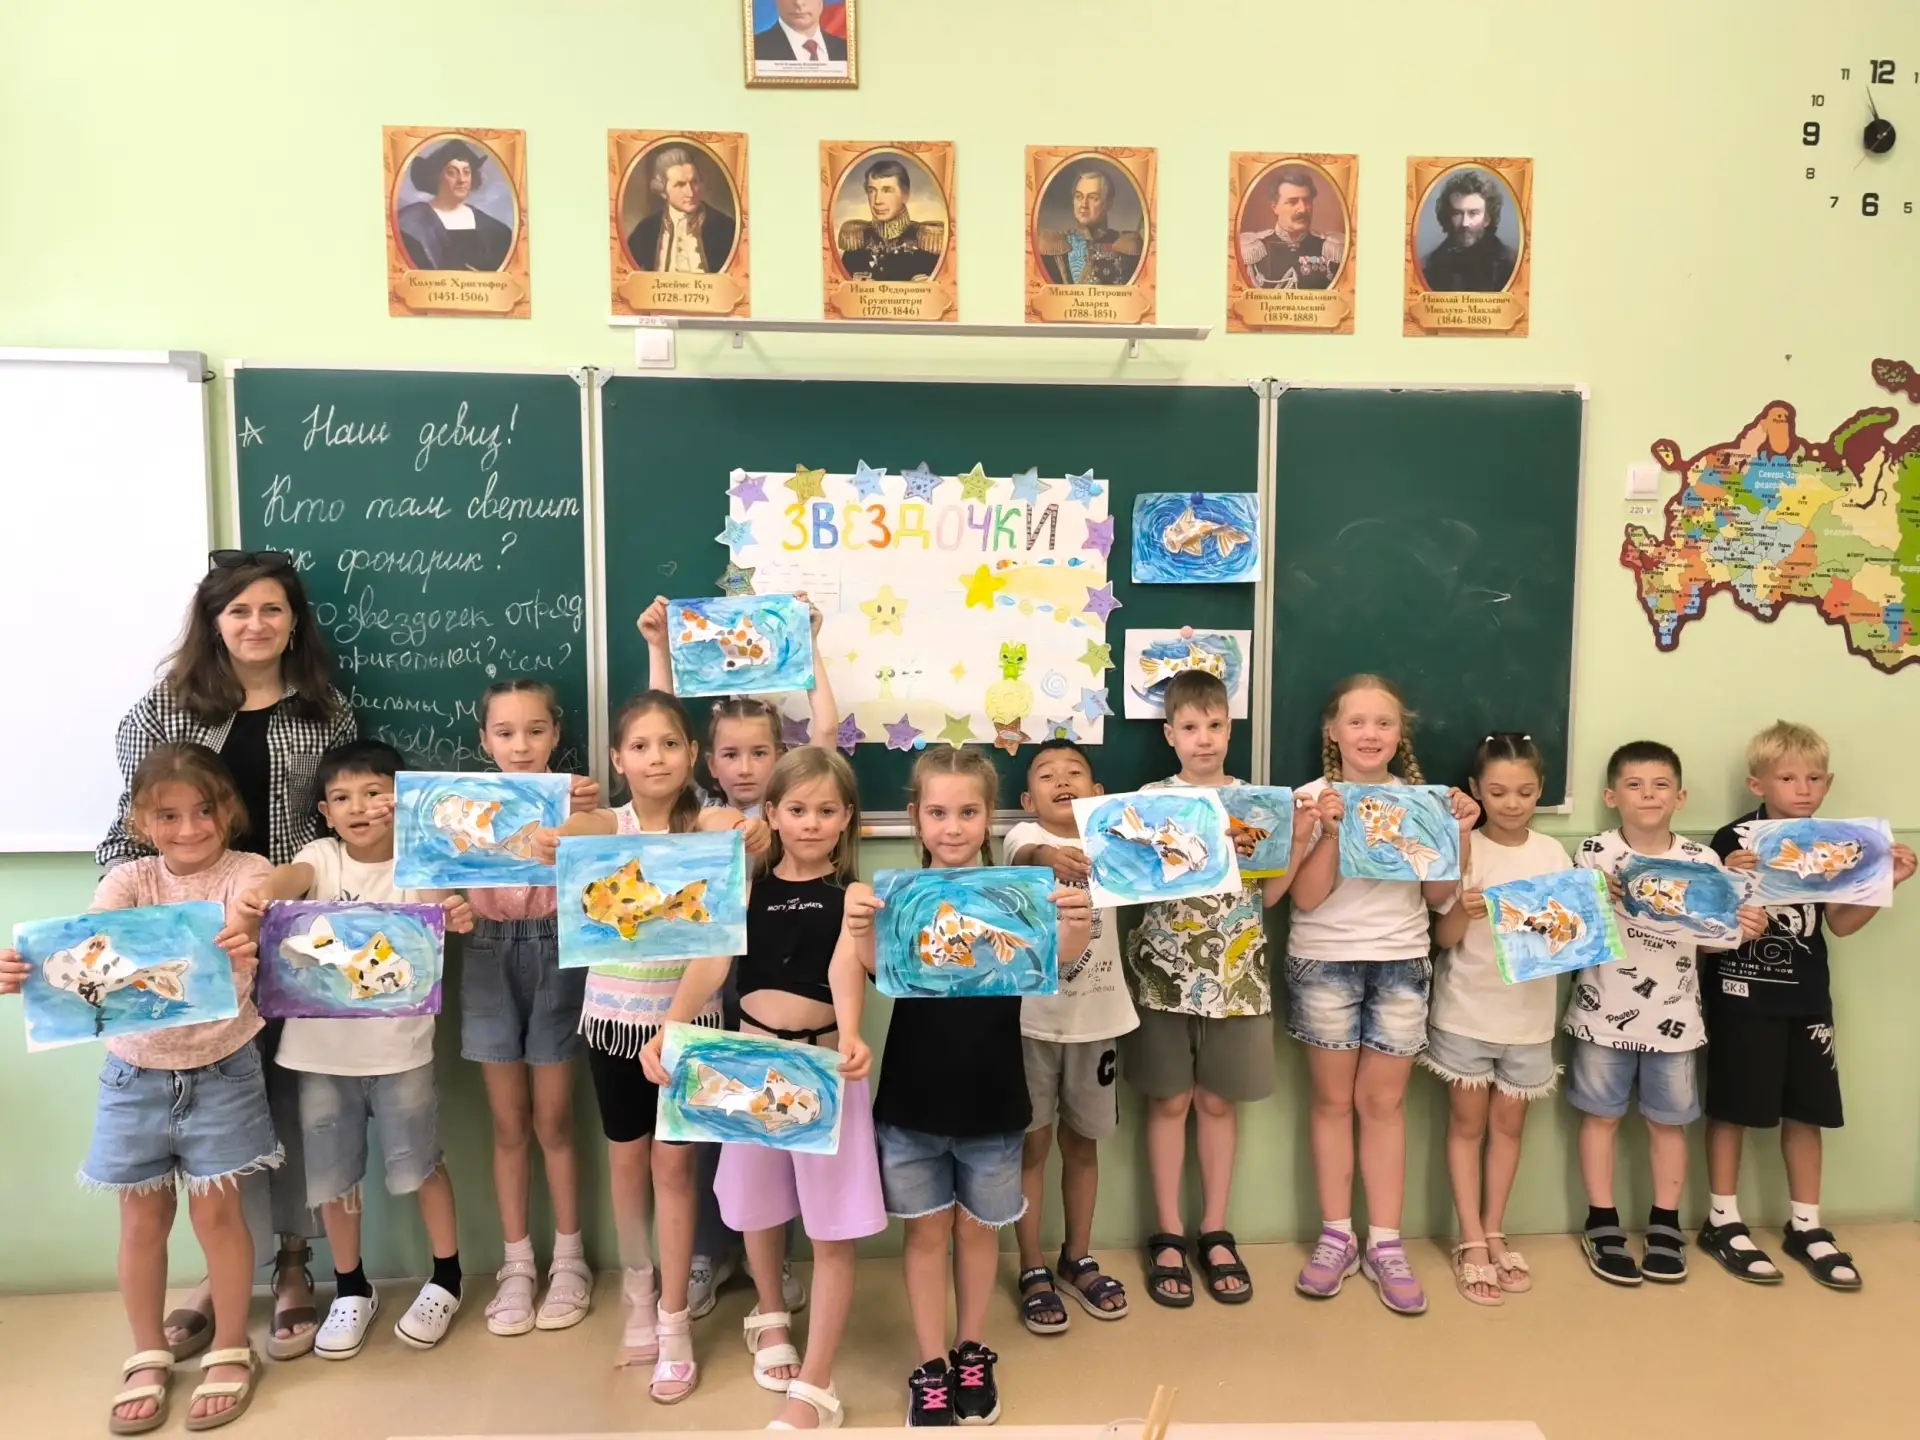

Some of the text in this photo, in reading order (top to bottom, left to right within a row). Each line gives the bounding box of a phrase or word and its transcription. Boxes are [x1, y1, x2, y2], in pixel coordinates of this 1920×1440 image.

[1841, 68, 1850, 80] 11
[1870, 60, 1896, 84] 12
[1811, 94, 1825, 107] 10
[1802, 121, 1820, 146] 9
[1805, 167, 1816, 180] 8
[1830, 196, 1839, 208] 7
[1862, 192, 1879, 217] 6
[1903, 202, 1913, 214] 5
[409, 277, 508, 290] Колумб Христофор
[651, 278, 714, 291] Джеймс Кук
[850, 284, 932, 295] Иван Федорович
[428, 292, 489, 302] (1451-1506)
[652, 293, 710, 304] (1728-1779)
[1088, 287, 1133, 298] Петрович
[1245, 291, 1338, 301] Николай Михайлович
[1071, 298, 1110, 308] Лазарев
[1422, 295, 1459, 304] Николай
[862, 306, 920, 316] (1770-1846)
[1063, 308, 1117, 319] (1788-1851)
[1437, 315, 1492, 325] (1846-1888)
[302, 403, 391, 451] Наш
[261, 471, 580, 527] Кто там светит
[1630, 506, 1644, 514] 220
[1643, 938, 1664, 950] TEAM
[1065, 948, 1093, 983] MONSTER!
[1740, 962, 1760, 970] TIME
[1632, 976, 1658, 1000] A
[1723, 980, 1747, 996] SK8
[1605, 1009, 1640, 1031] Power
[1657, 1018, 1686, 1039] 45
[1612, 1041, 1664, 1052] COURA
